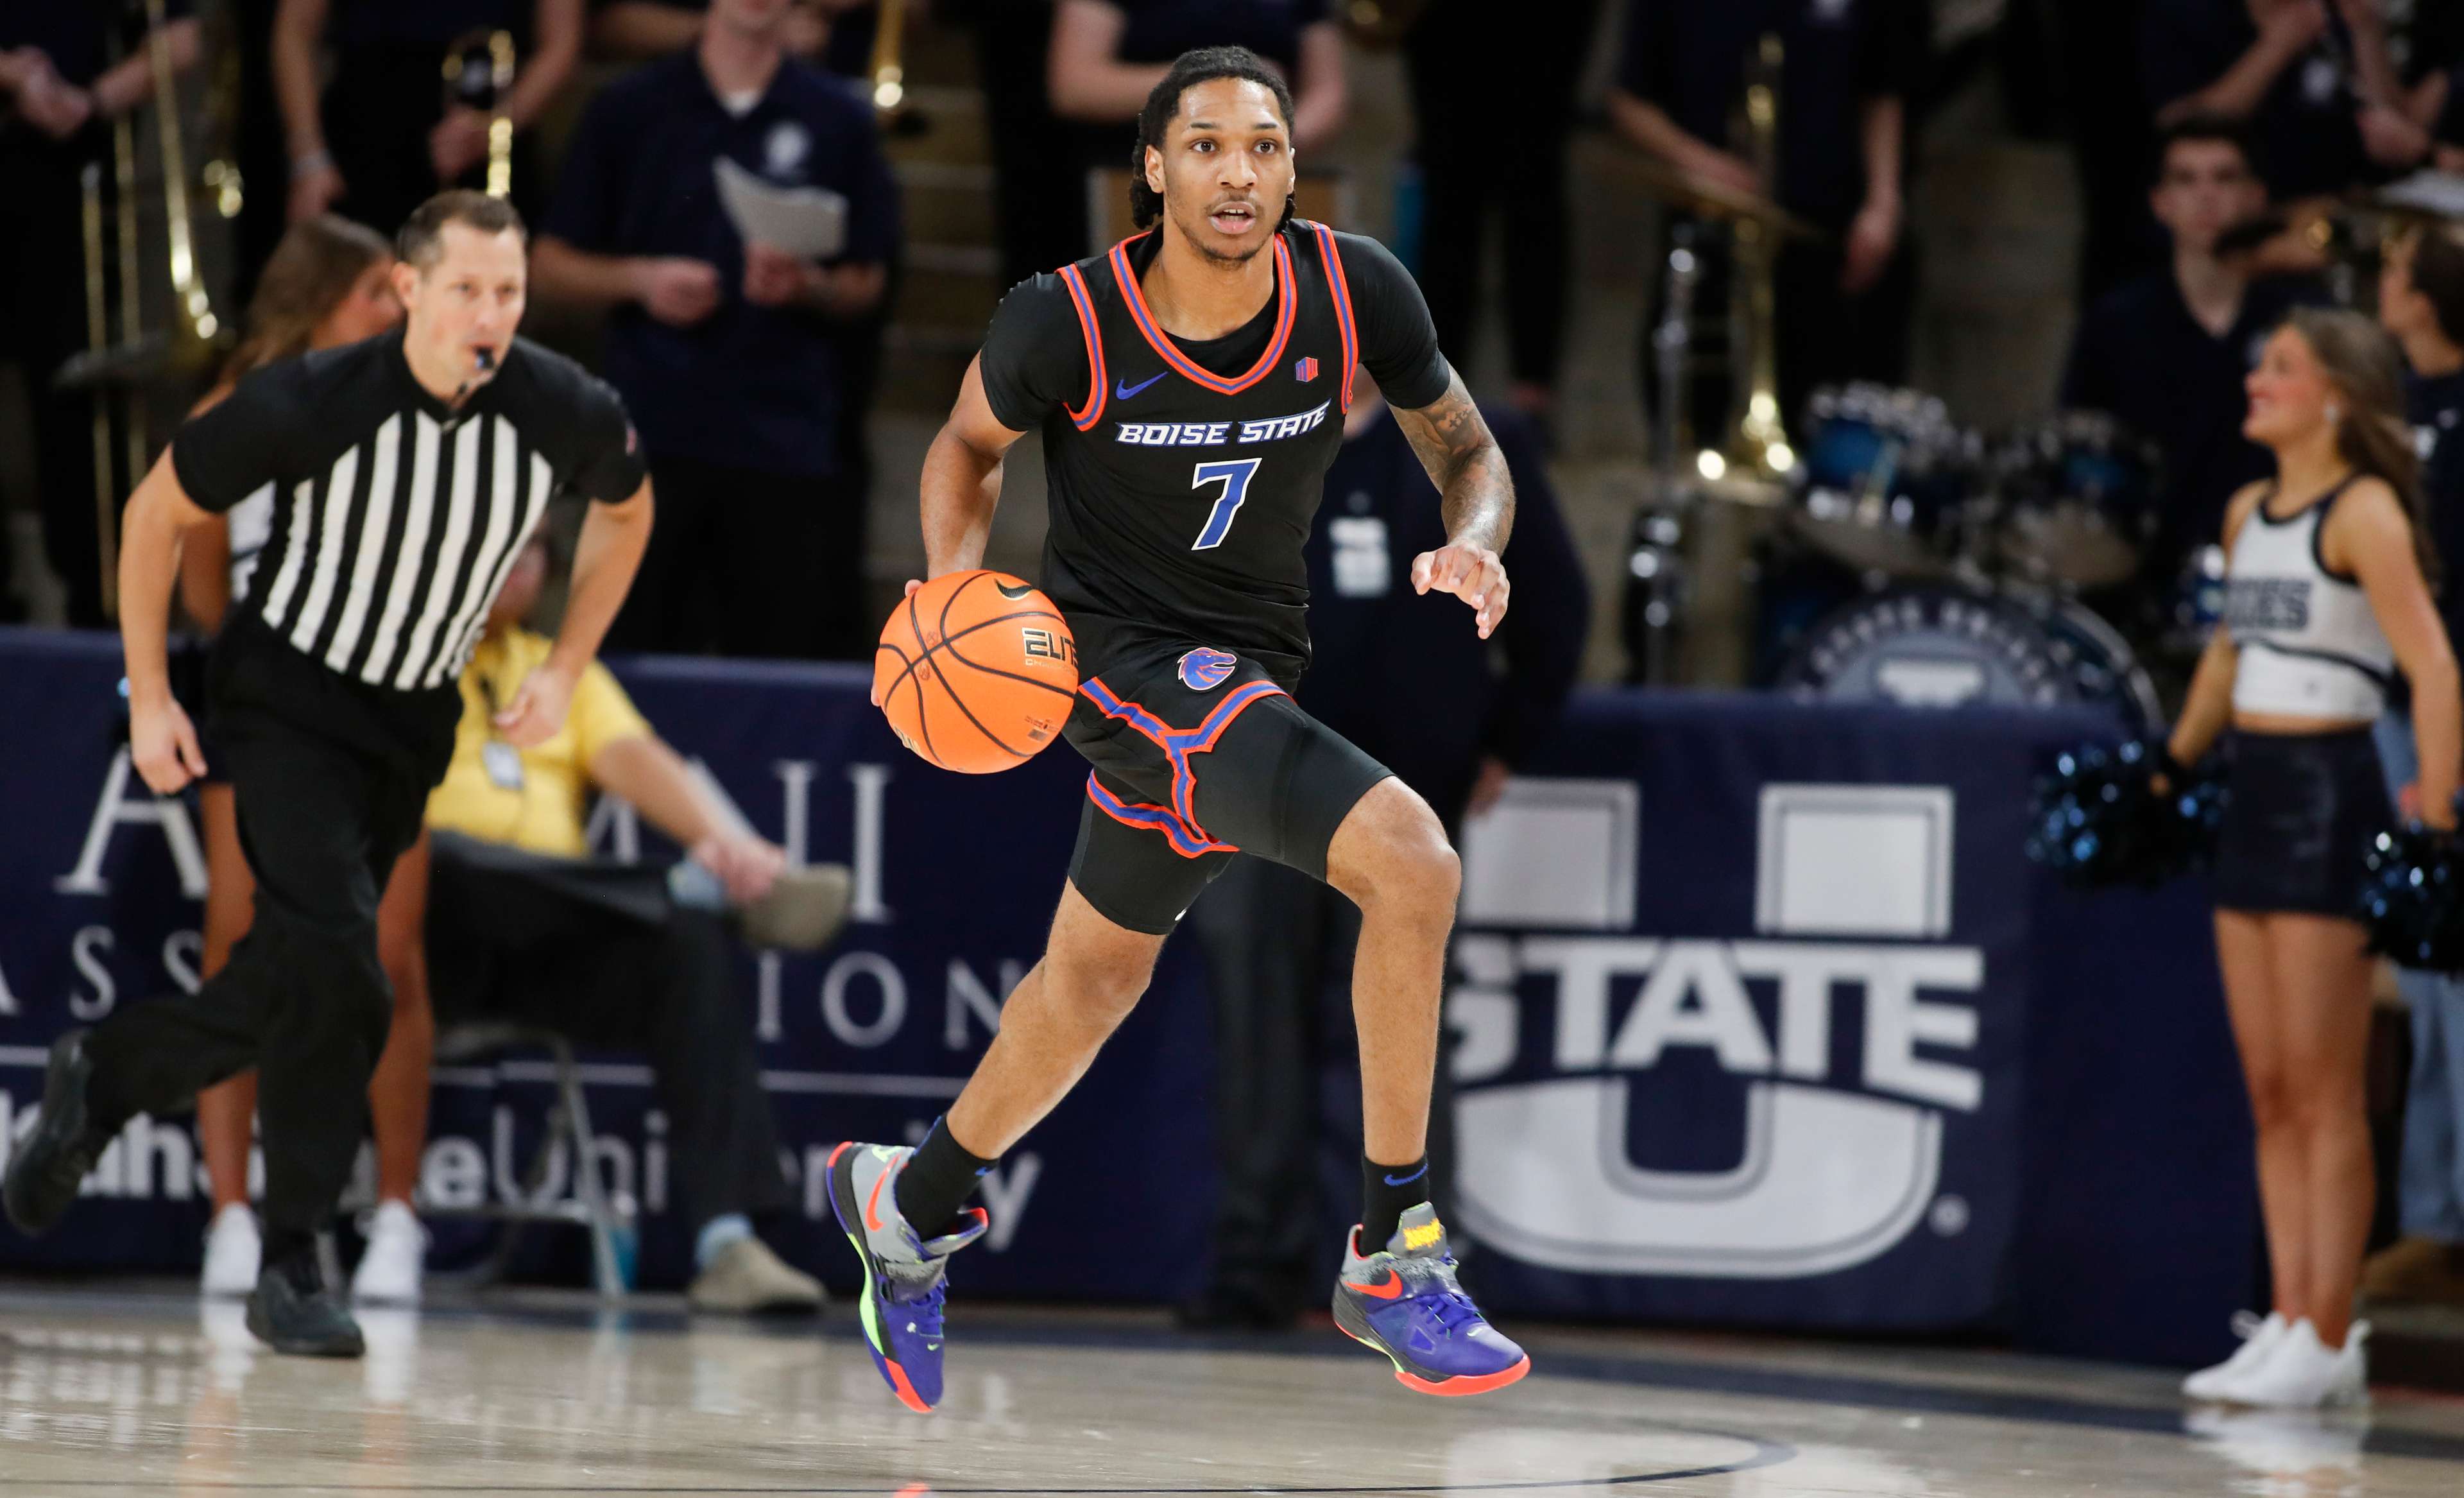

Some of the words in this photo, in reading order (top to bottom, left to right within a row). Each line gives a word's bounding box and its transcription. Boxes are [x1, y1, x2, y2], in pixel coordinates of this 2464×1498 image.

[1115, 422, 1233, 447] BOISE
[1236, 398, 1331, 444] STATE
[1191, 457, 1262, 551] 7
[1448, 934, 1985, 1113] STATE
